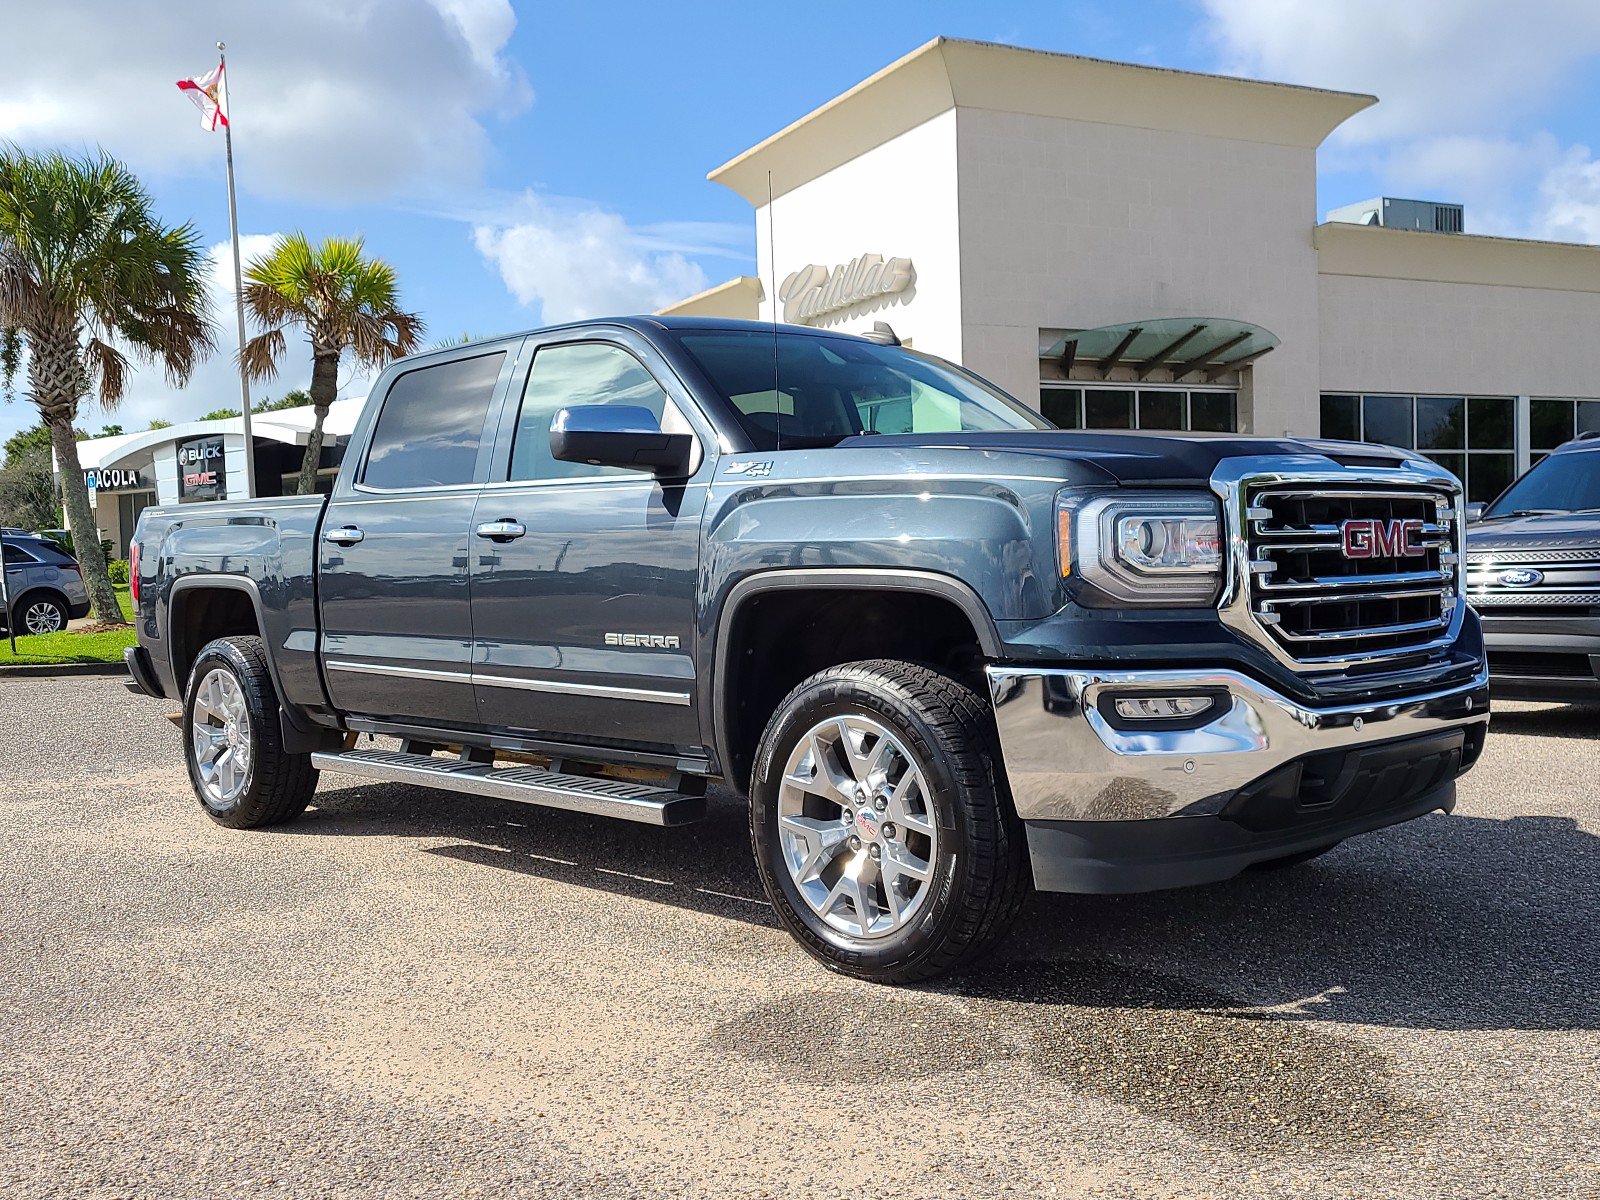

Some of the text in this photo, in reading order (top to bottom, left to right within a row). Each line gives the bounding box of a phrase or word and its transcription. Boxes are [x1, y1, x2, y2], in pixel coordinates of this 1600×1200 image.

[779, 253, 917, 325] Cadillac
[188, 445, 222, 461] BUICK
[184, 472, 217, 487] GMC
[1342, 518, 1426, 559] GMC
[604, 632, 681, 649] SIERRA
[855, 813, 877, 837] GMC
